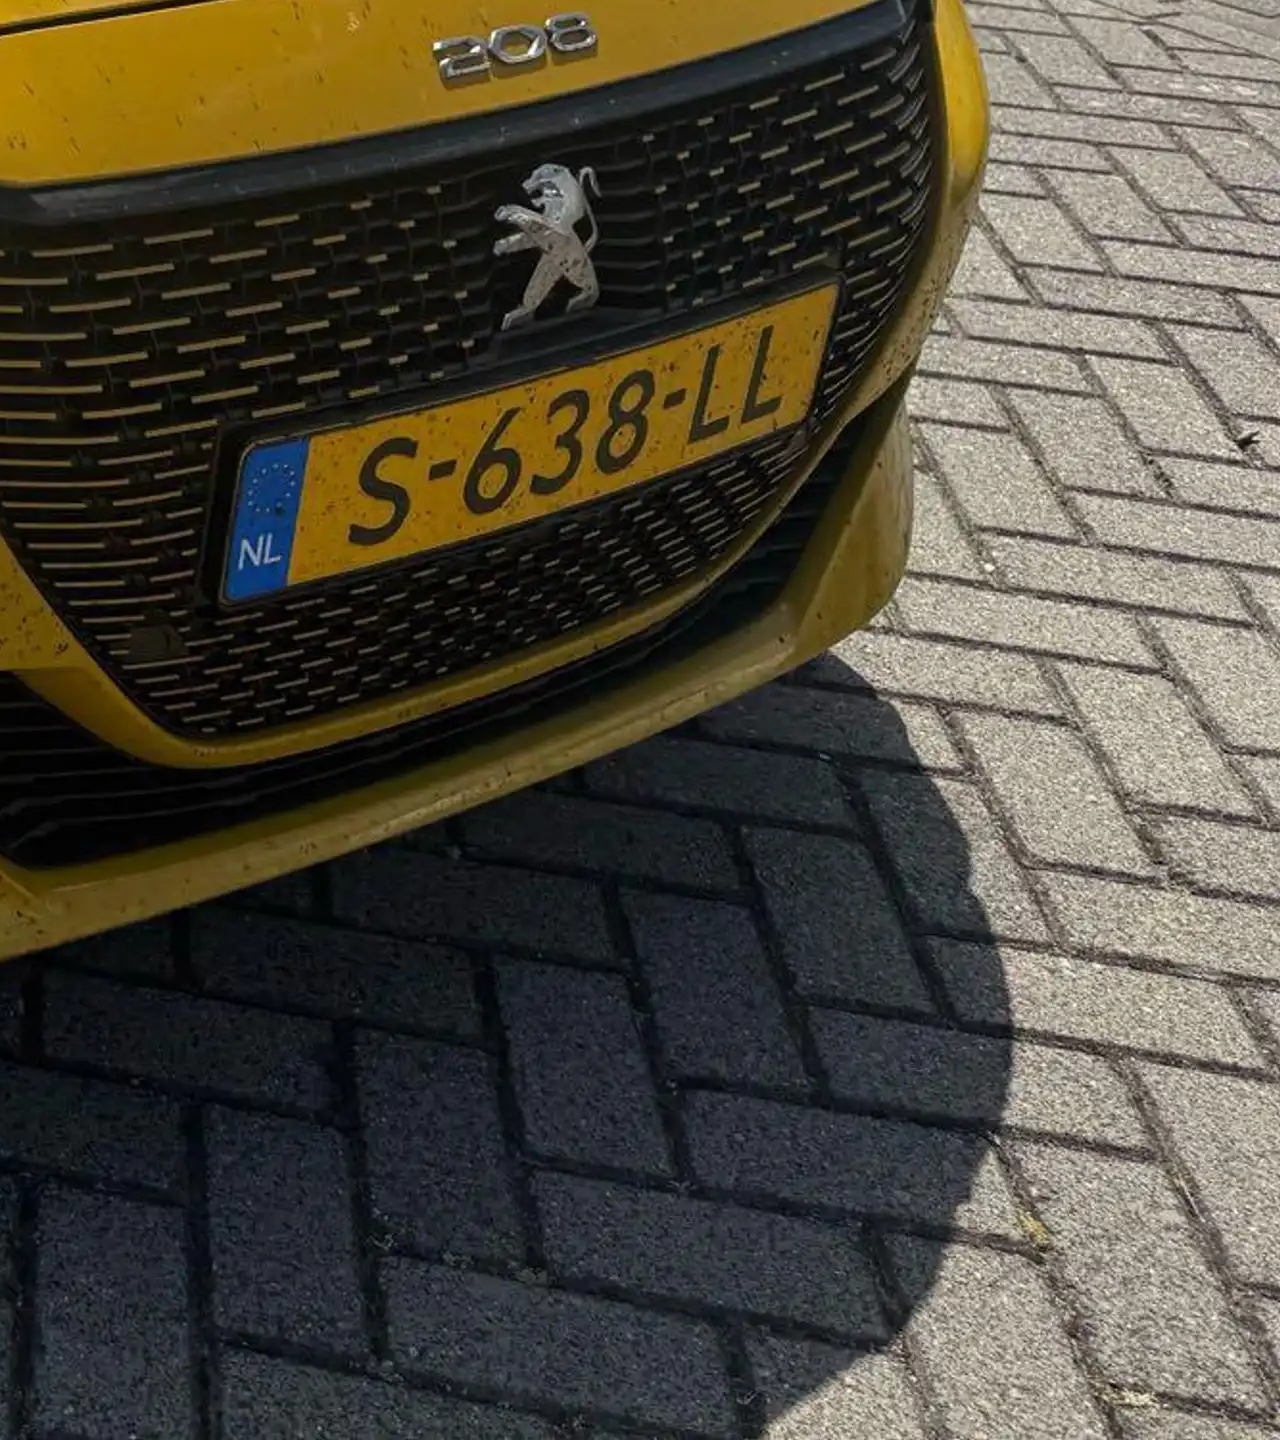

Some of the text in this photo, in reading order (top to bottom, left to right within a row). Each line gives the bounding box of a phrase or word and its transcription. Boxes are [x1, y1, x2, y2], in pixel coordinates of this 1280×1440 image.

[432, 12, 597, 78] 208
[347, 324, 783, 547] S-638-LL
[237, 535, 282, 571] NL
